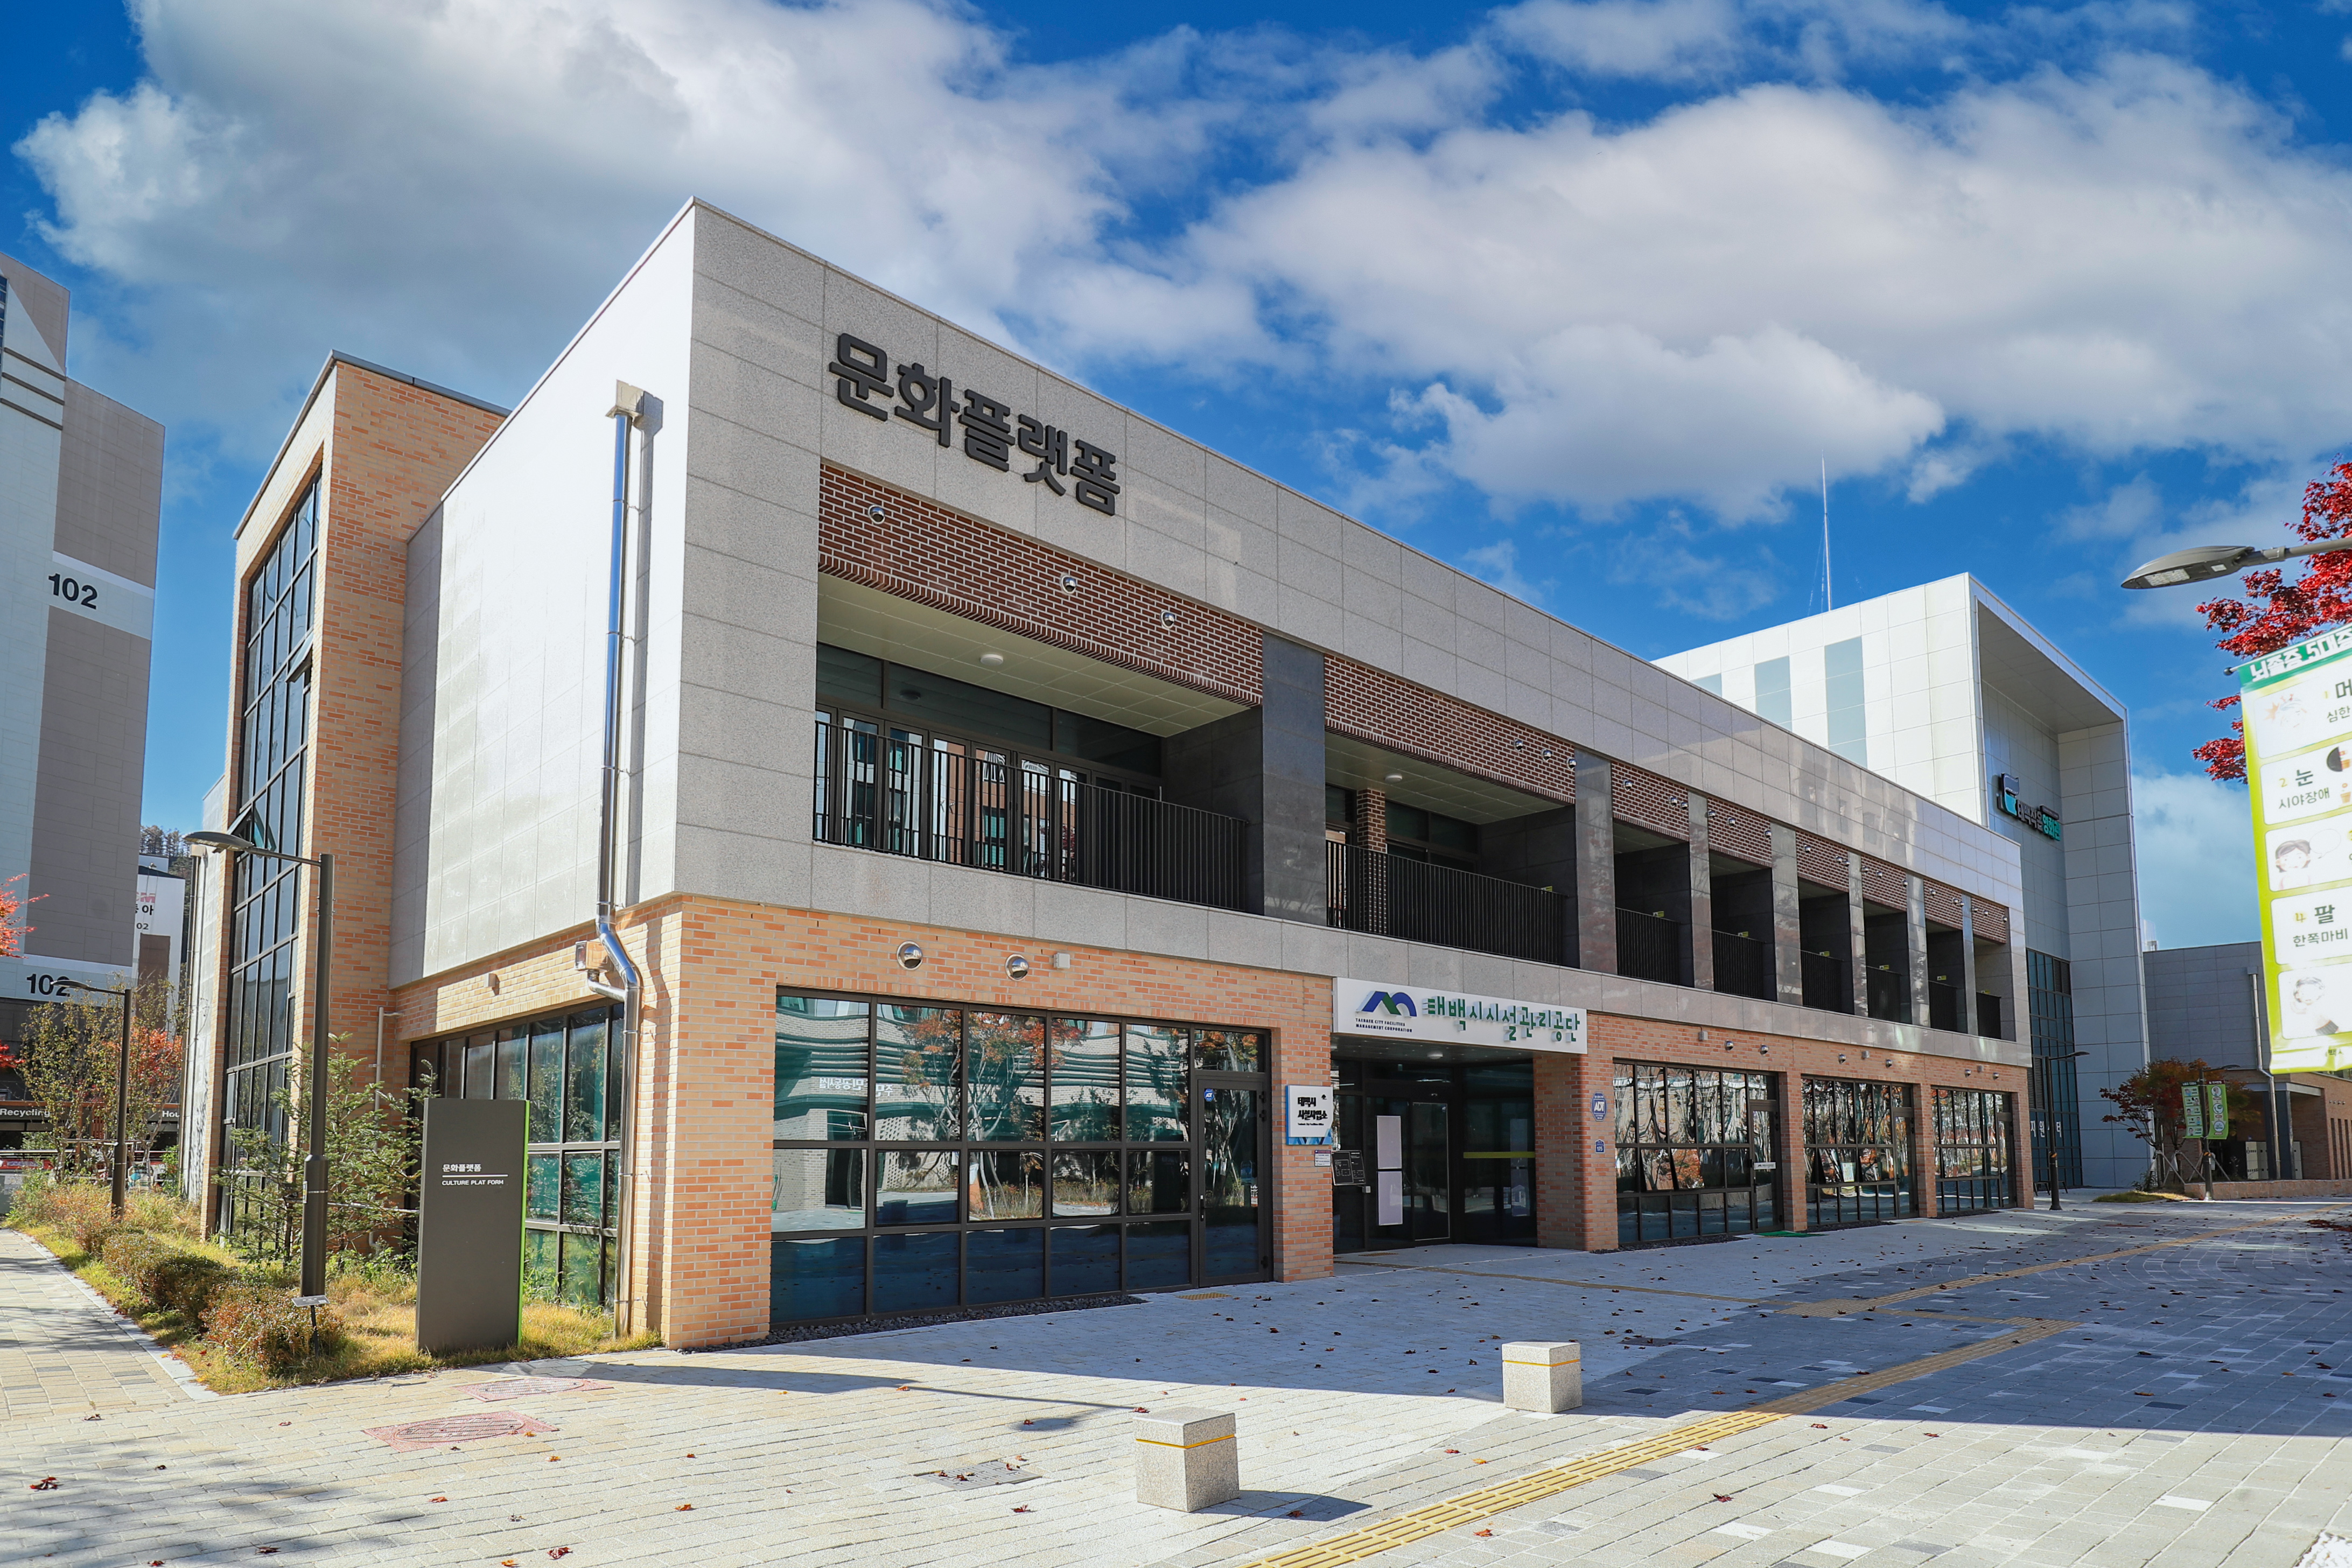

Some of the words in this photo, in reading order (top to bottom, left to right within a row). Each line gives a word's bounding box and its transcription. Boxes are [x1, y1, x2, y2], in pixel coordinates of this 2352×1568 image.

[829, 333, 1121, 516] 문화플랫폼
[48, 573, 98, 610] 102
[2327, 705, 2351, 723] 심한
[2279, 778, 2287, 787] 2
[2295, 769, 2314, 787] 눈
[2279, 787, 2330, 809] 시야장애
[2295, 913, 2306, 923] 4
[2314, 904, 2335, 925] 팔
[2293, 928, 2348, 947] 한쪽마비
[26, 973, 70, 997] 102
[1423, 995, 1580, 1042] 태백시시설관리공단
[1297, 1097, 1317, 1108] 태백시
[1594, 1101, 1605, 1112] ADT
[0, 1108, 51, 1118] Recycling
[1297, 1110, 1328, 1121] 시설사업소
[2030, 1121, 2062, 1138] 지원터
[442, 1164, 482, 1172] 문화플랫폼
